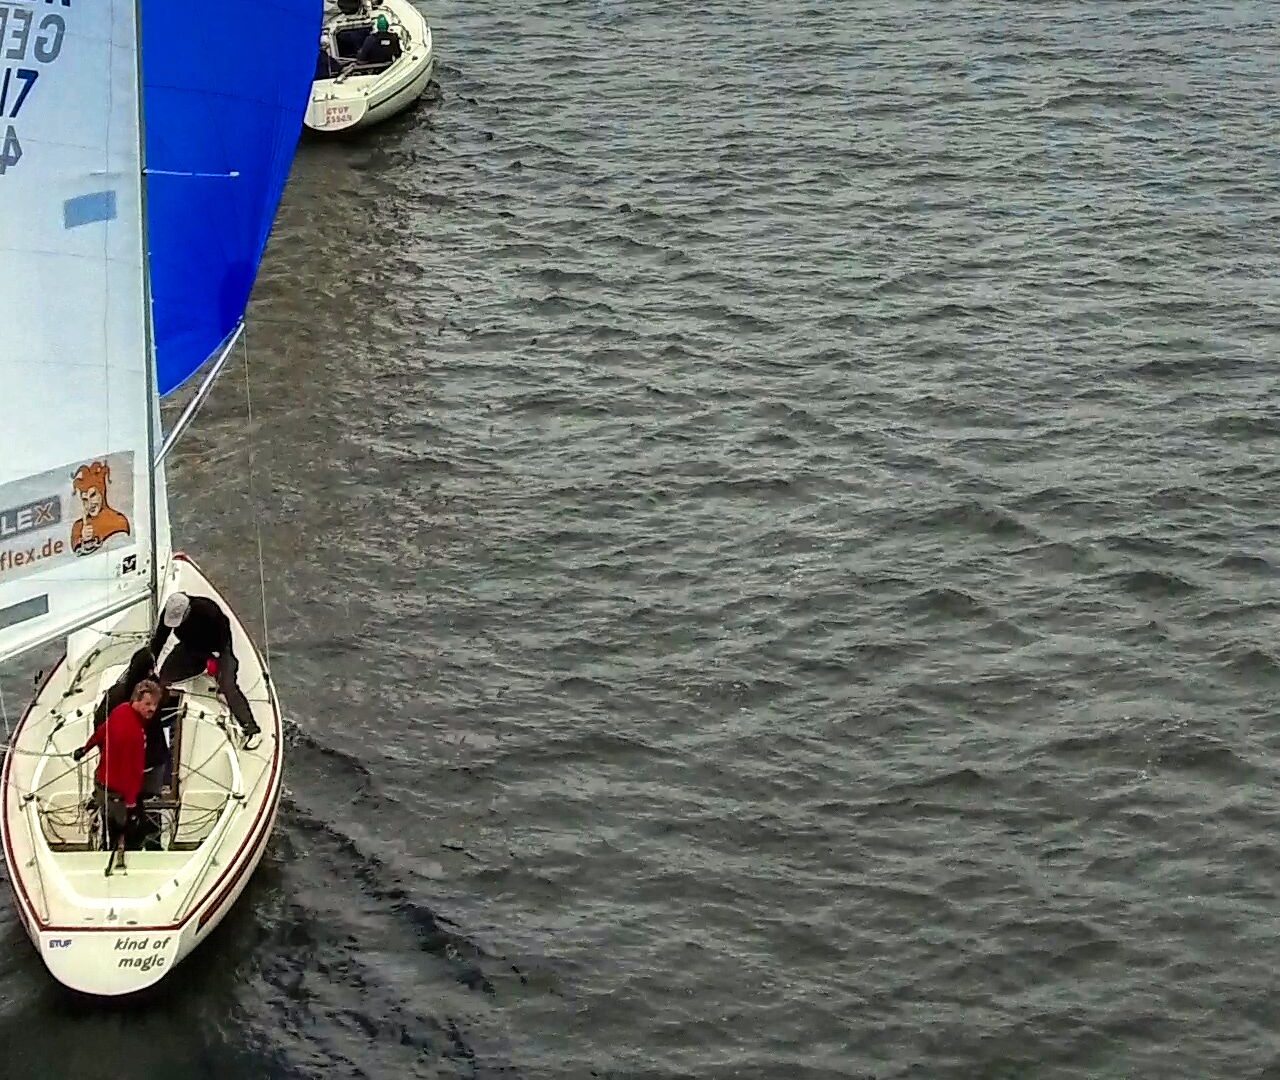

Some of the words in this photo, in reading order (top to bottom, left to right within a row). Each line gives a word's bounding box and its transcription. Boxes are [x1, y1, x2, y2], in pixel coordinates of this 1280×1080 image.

[114, 937, 149, 950] kind
[152, 936, 171, 949] of
[118, 953, 165, 971] magic
